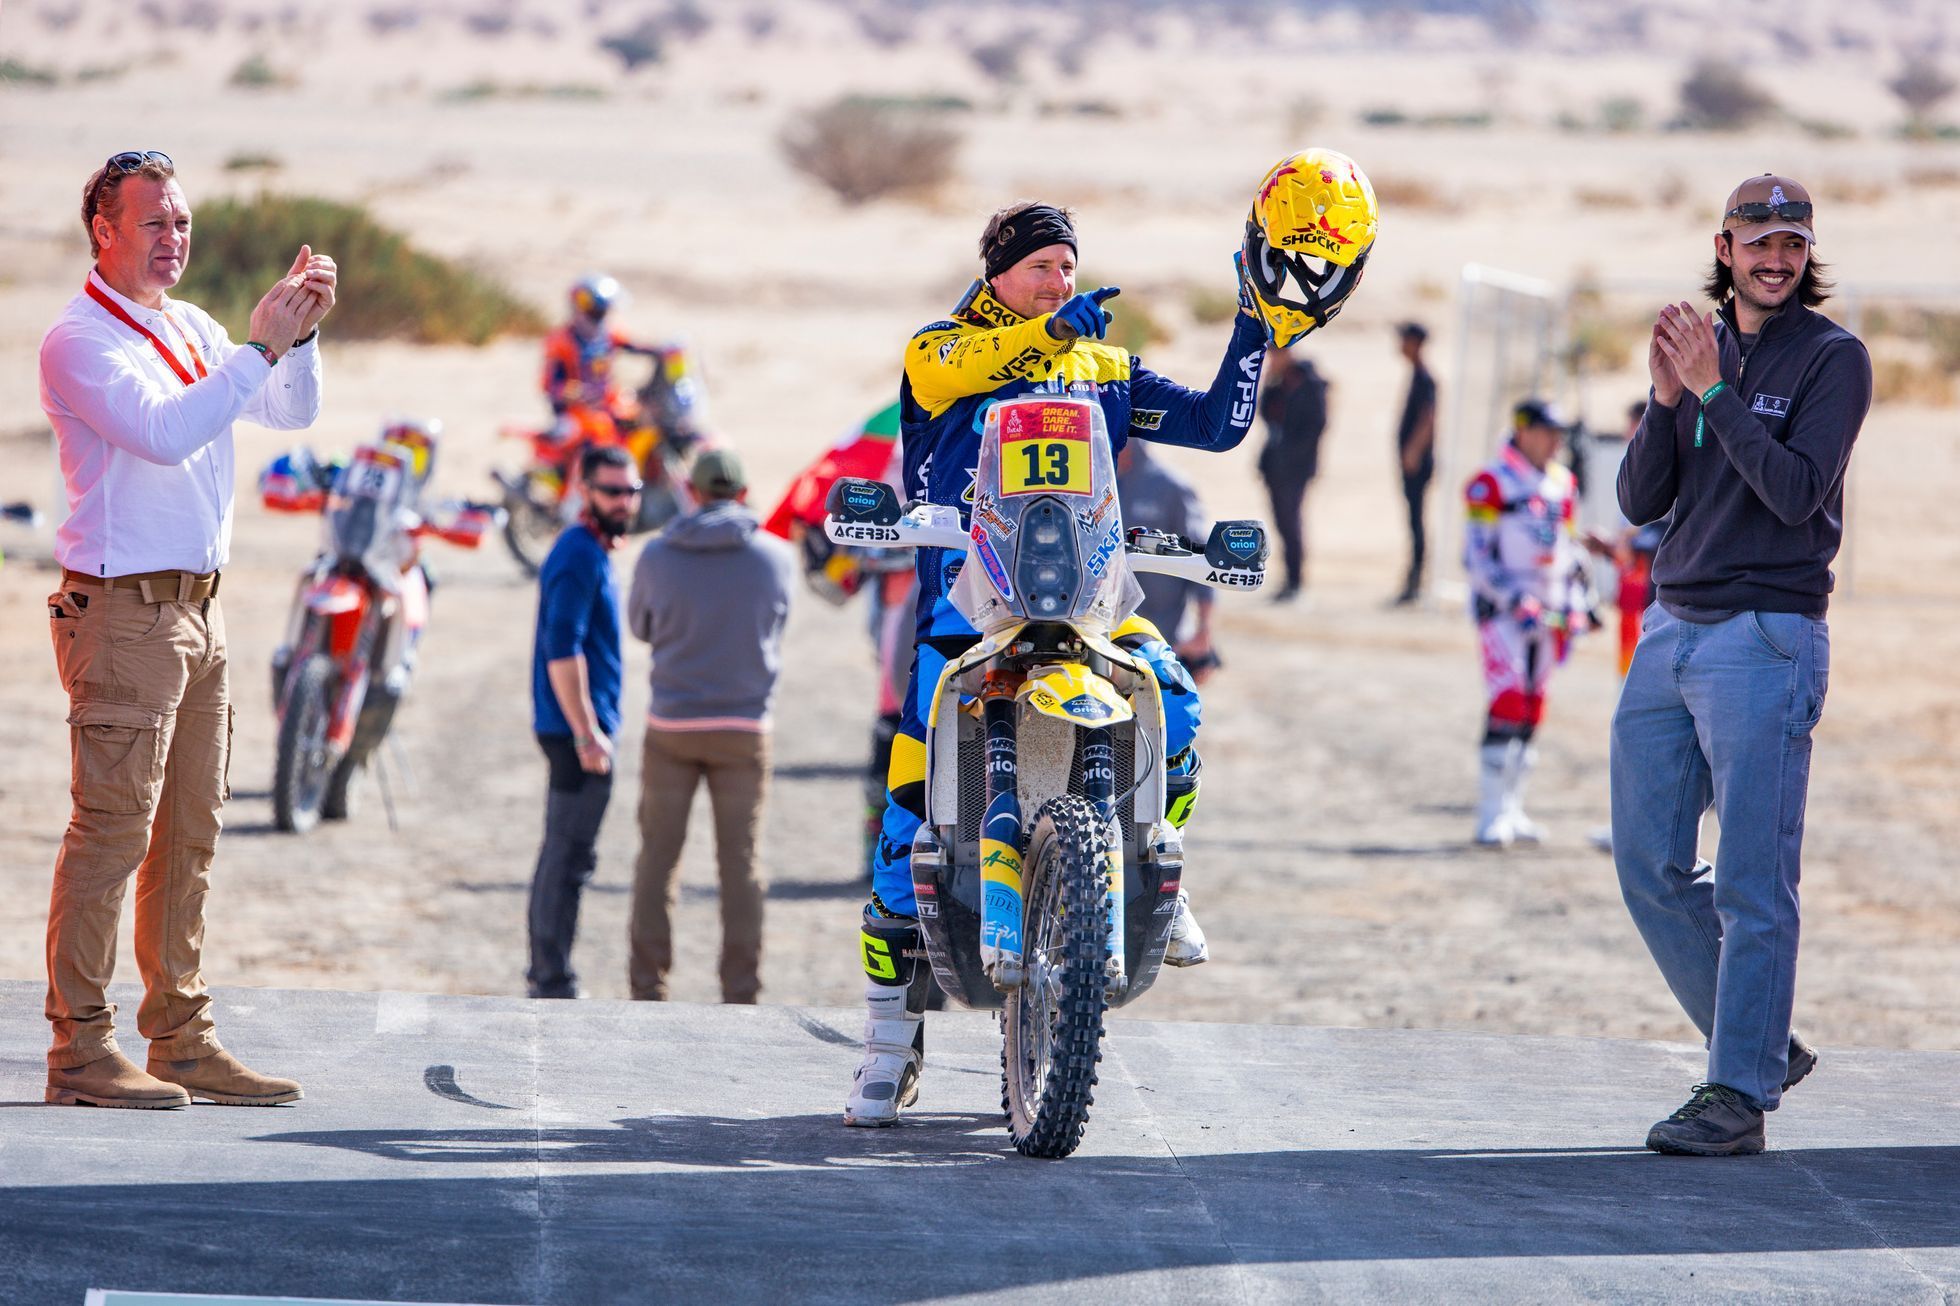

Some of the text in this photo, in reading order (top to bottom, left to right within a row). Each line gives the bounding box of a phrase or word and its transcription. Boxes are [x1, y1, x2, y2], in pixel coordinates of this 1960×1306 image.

[1316, 230, 1328, 238] BIG
[1281, 233, 1341, 256] SHOCK!
[1042, 407, 1080, 418] DREAM.
[1042, 416, 1072, 425] DARE.
[1042, 424, 1077, 434] LIVE IT.
[1021, 443, 1070, 487] 13
[848, 495, 876, 506] orion
[1086, 519, 1121, 578] SKF
[1230, 539, 1256, 549] orion
[1072, 704, 1107, 716] orion
